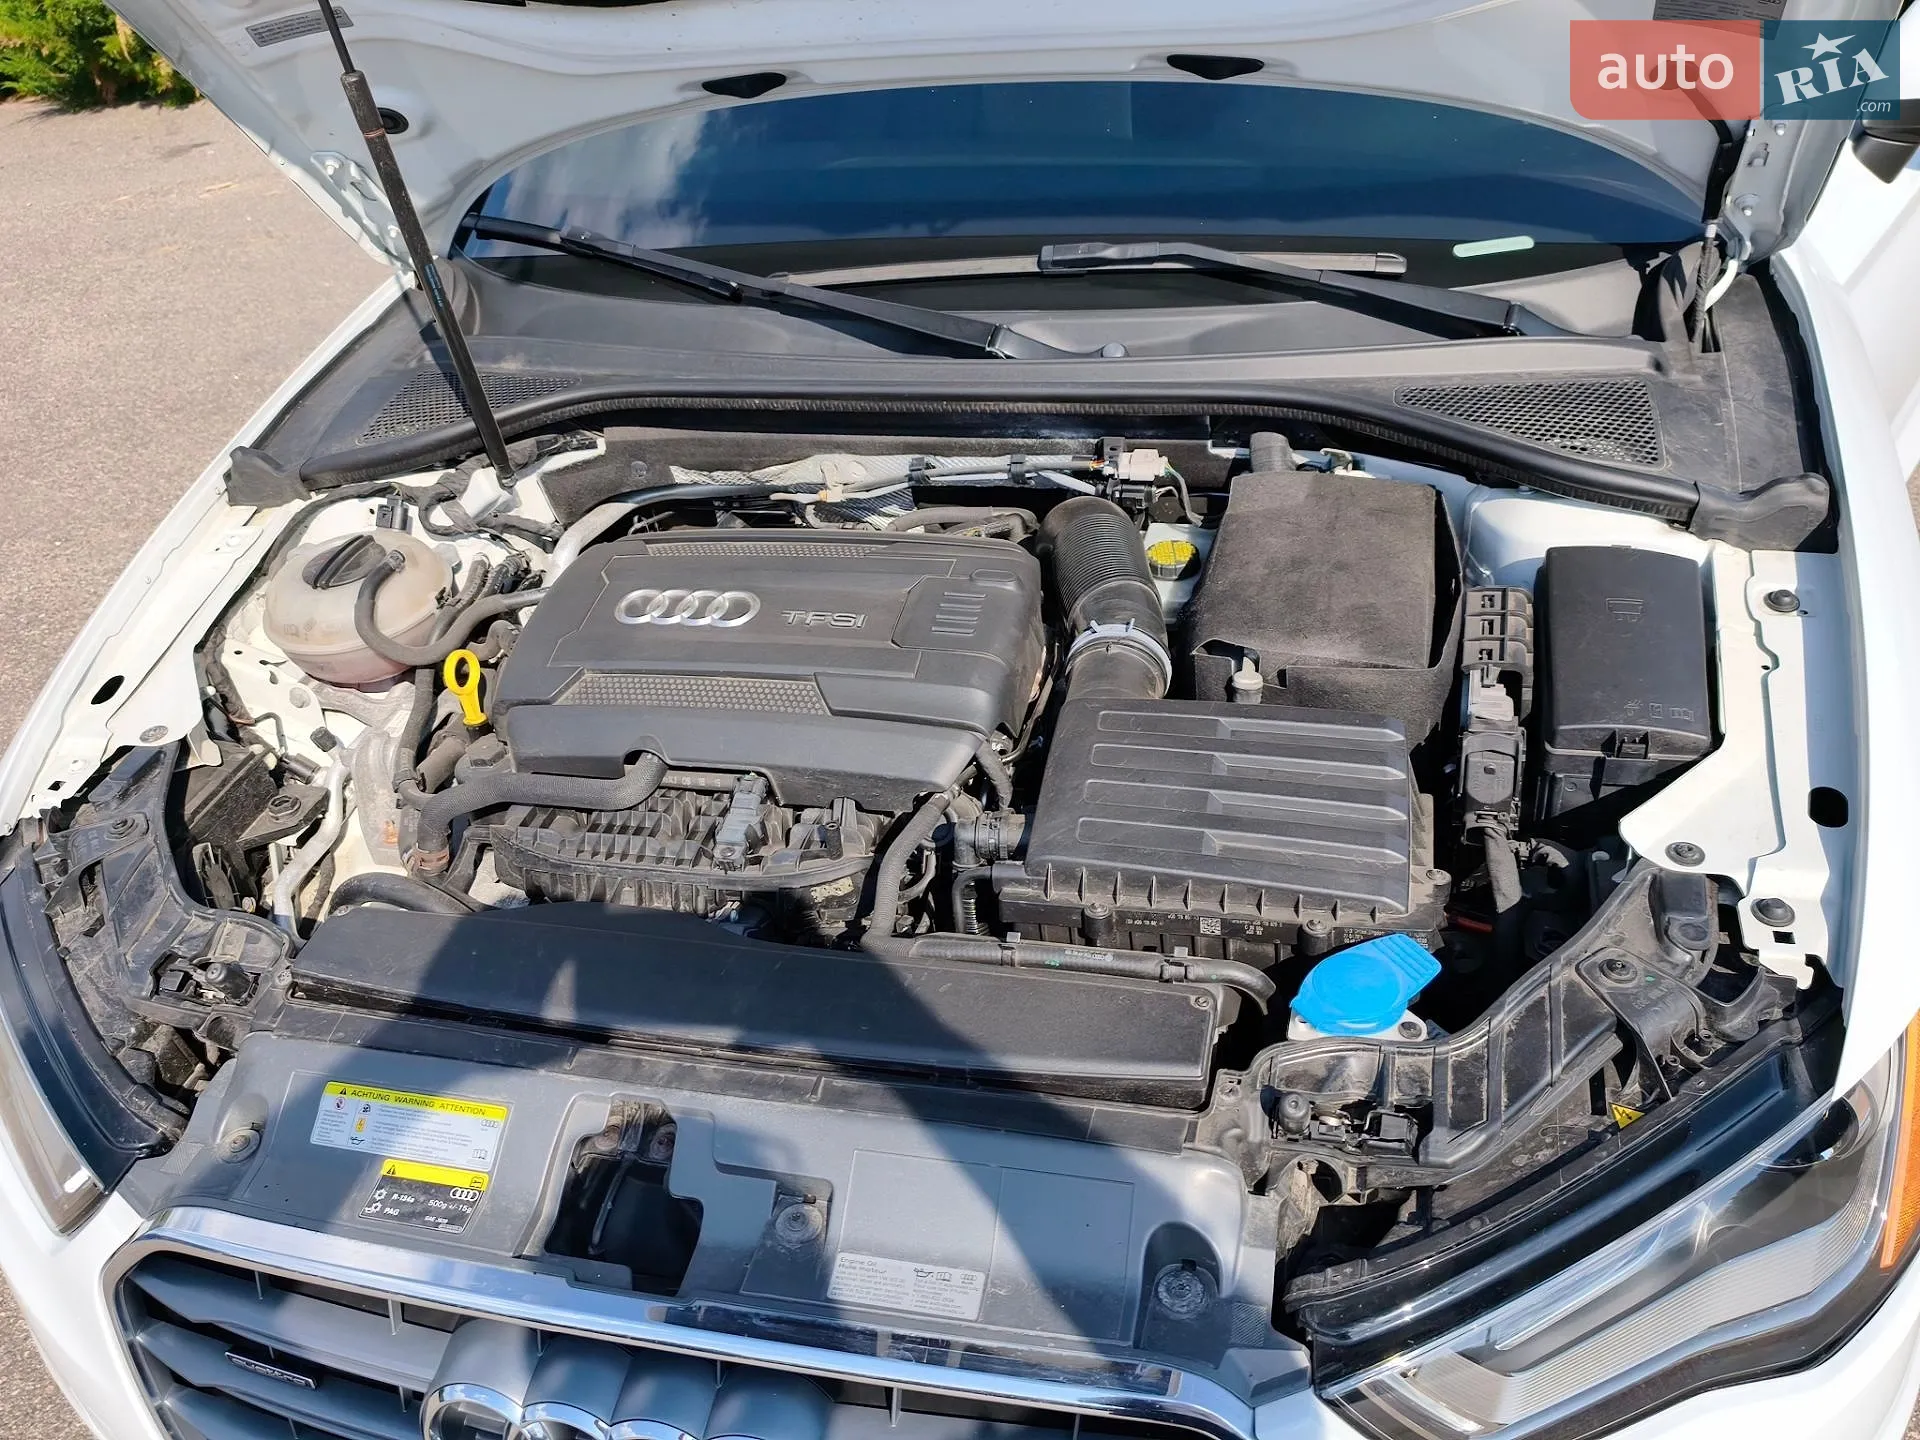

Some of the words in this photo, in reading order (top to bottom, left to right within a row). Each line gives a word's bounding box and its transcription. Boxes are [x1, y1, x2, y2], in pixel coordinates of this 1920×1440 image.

[780, 609, 868, 629] TFSI
[351, 1089, 390, 1102] ACHTUNG
[394, 1095, 435, 1108] WARNING
[439, 1103, 486, 1115] ATTENTION
[427, 1199, 448, 1210] 500g
[383, 1207, 400, 1216] PAG
[840, 1256, 865, 1266] Engine
[866, 1259, 877, 1267] Oil
[861, 1265, 888, 1274] moteur
[231, 1357, 306, 1386] quattro
